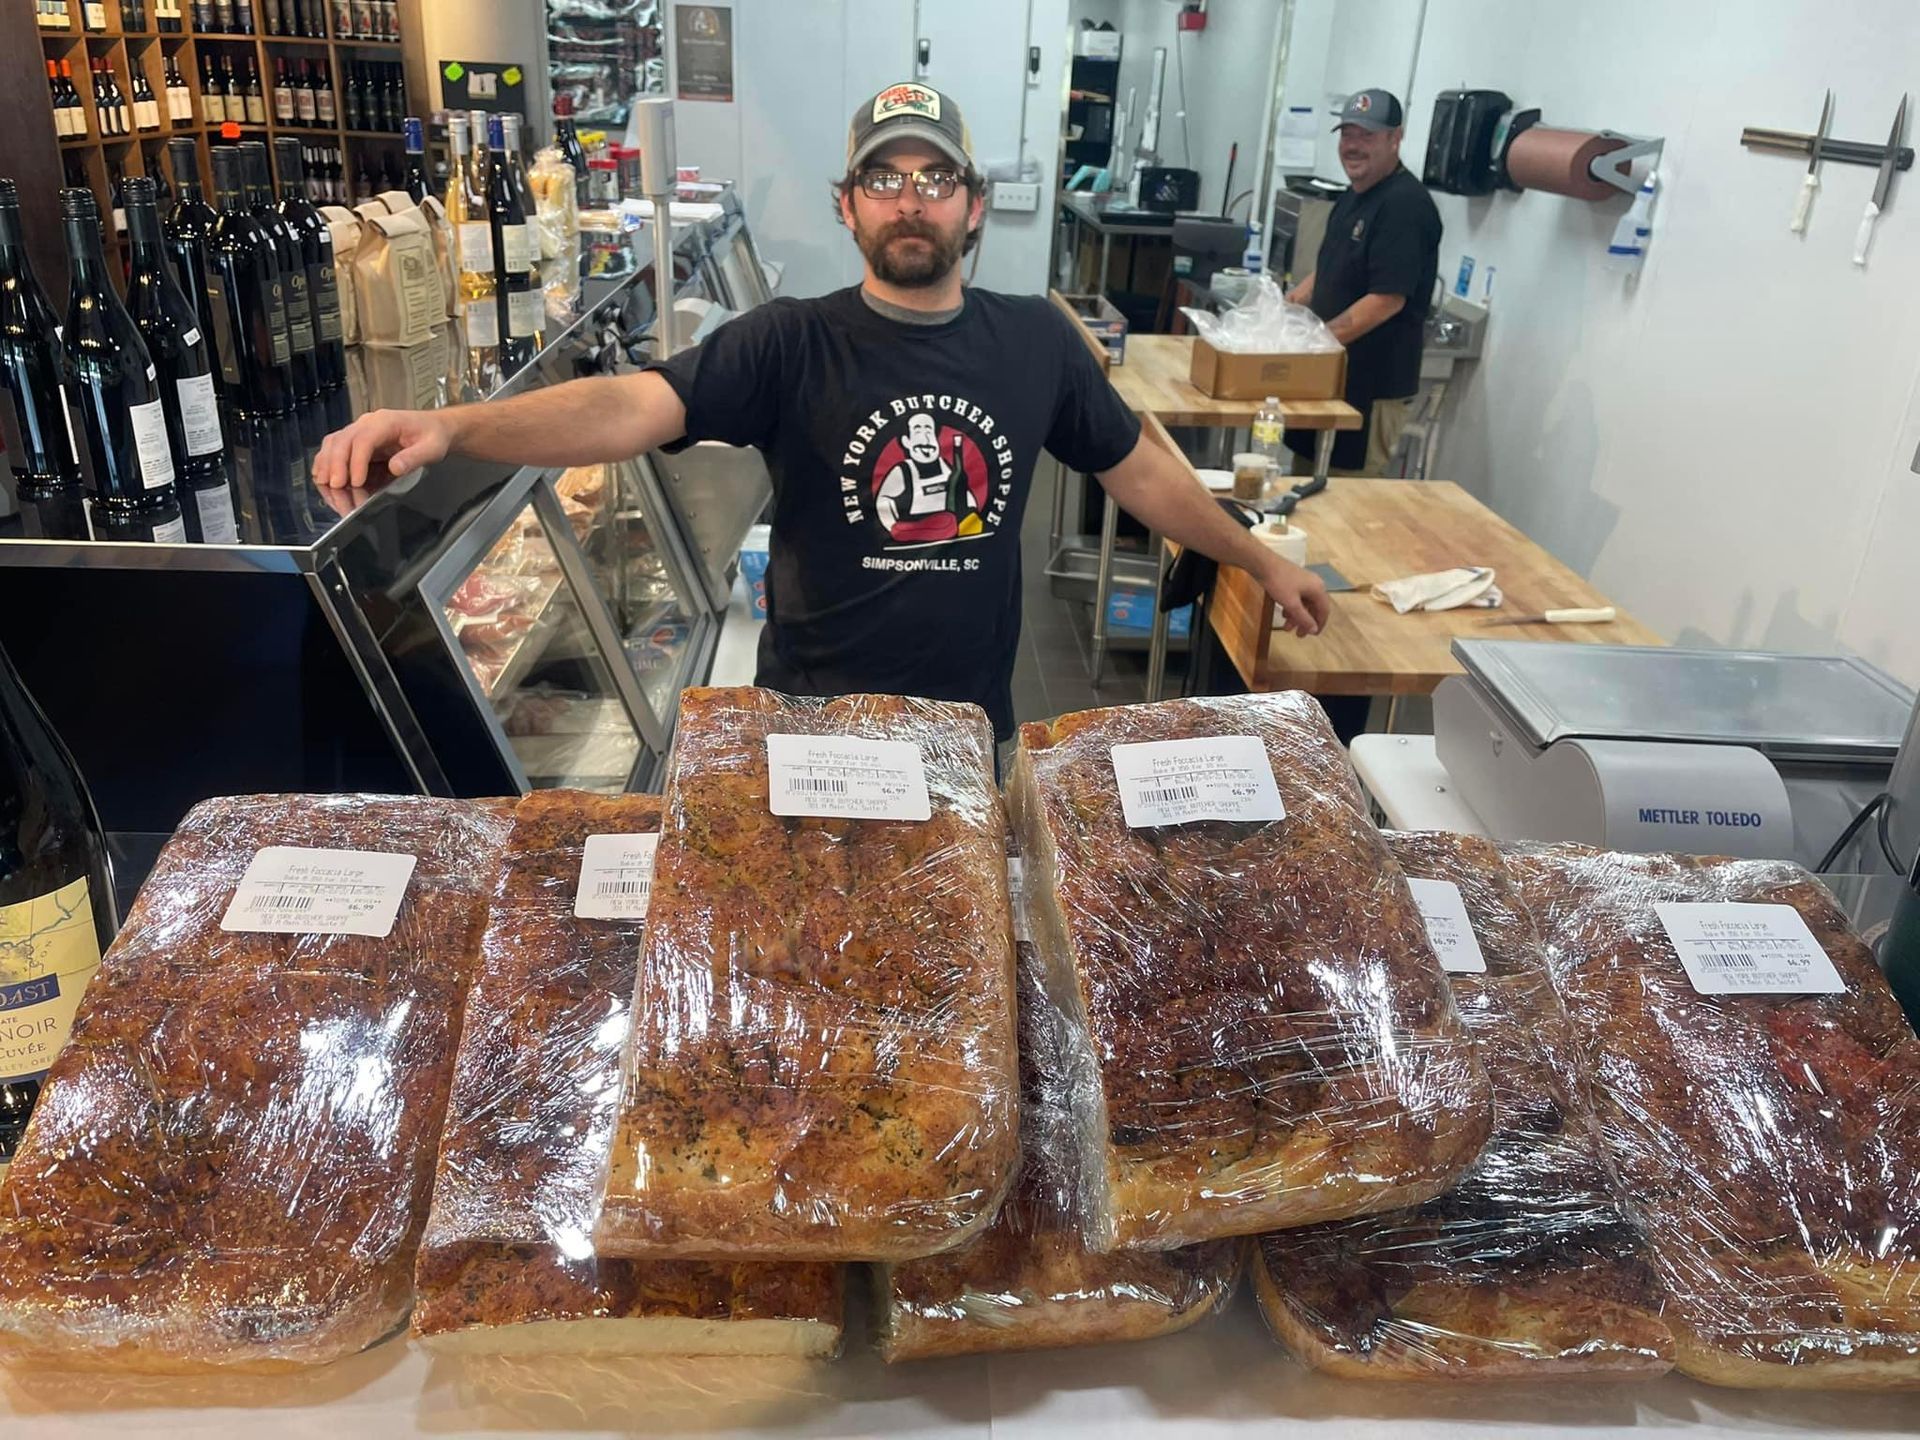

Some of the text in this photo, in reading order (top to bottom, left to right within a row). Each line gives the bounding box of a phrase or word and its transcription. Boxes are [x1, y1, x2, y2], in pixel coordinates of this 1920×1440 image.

[840, 394, 1013, 526] NEW YORK BUTCHER SHOPPE
[862, 556, 980, 572] SIMPSONVILLE, SC
[860, 753, 879, 762] Large
[1152, 758, 1171, 767] Fresh
[1205, 754, 1224, 762] Large
[1639, 809, 1761, 827] METTLER TOLEDO
[344, 869, 364, 878] Large
[0, 1017, 57, 1042] NOIR
